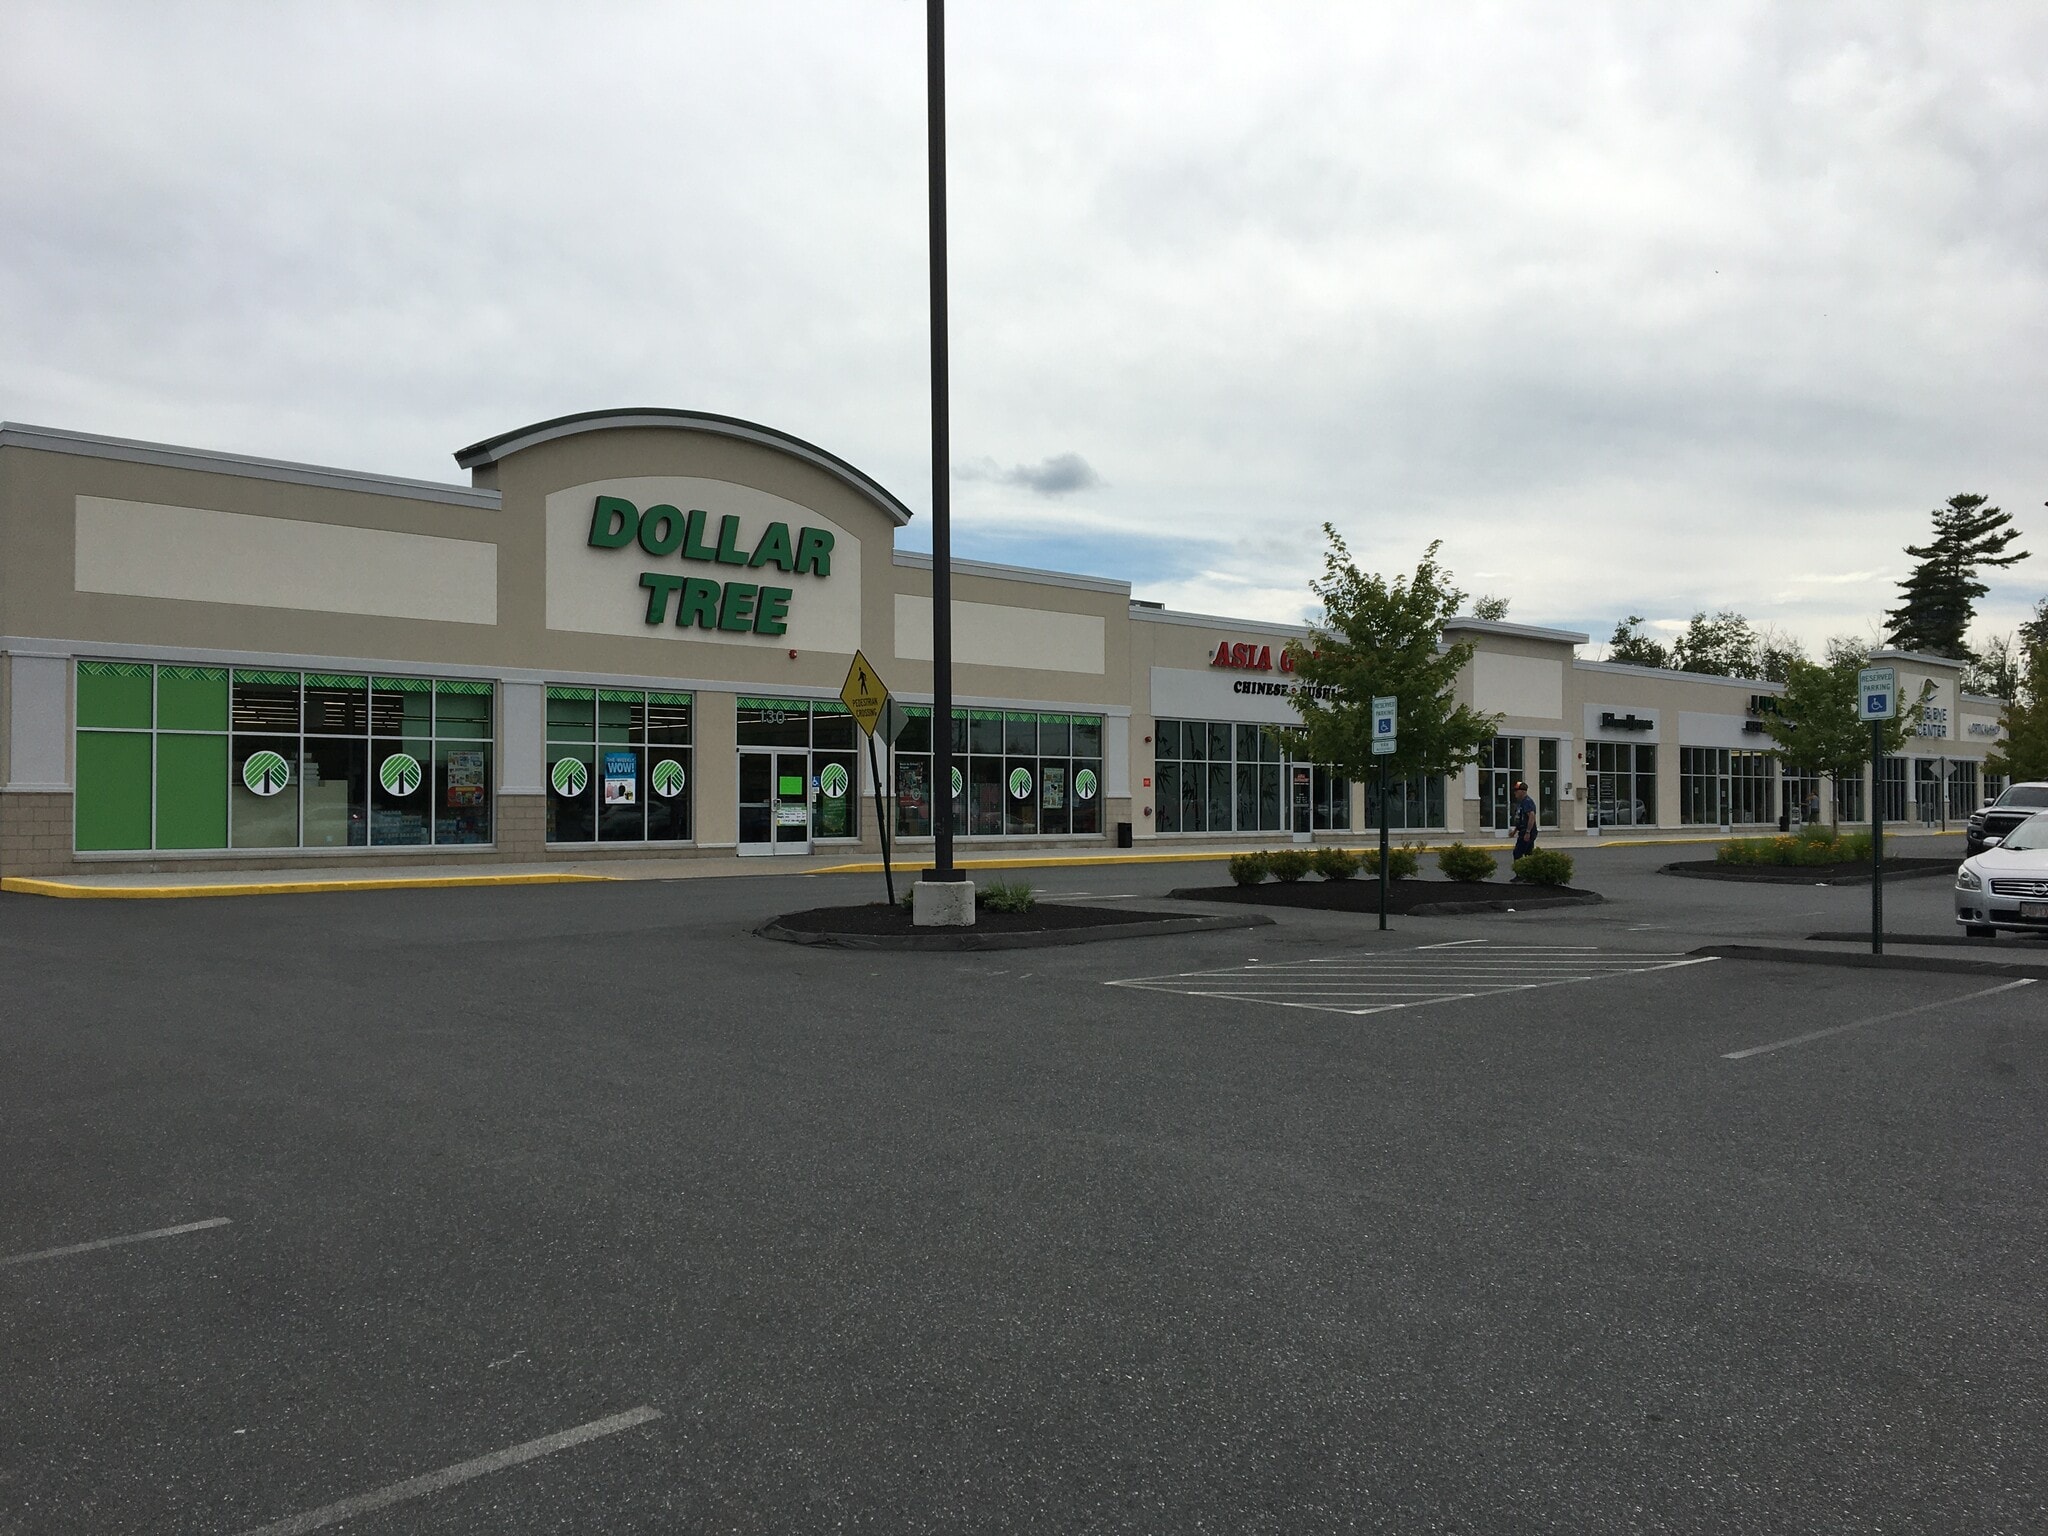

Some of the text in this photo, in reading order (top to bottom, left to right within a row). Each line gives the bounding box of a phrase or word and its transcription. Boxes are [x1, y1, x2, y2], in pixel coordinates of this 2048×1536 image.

[587, 495, 835, 577] DOLLAR
[639, 572, 793, 635] TREE
[1212, 641, 1273, 671] ASIA
[1861, 673, 1893, 683] RESERVED
[1233, 681, 1288, 697] CHINESE
[1863, 683, 1891, 693] PARKING
[852, 698, 878, 707] PEDESTRIAN
[760, 709, 786, 725] 130
[856, 708, 877, 718] CROSSING
[1916, 723, 1947, 738] CENTER
[607, 762, 635, 773] WOW!
